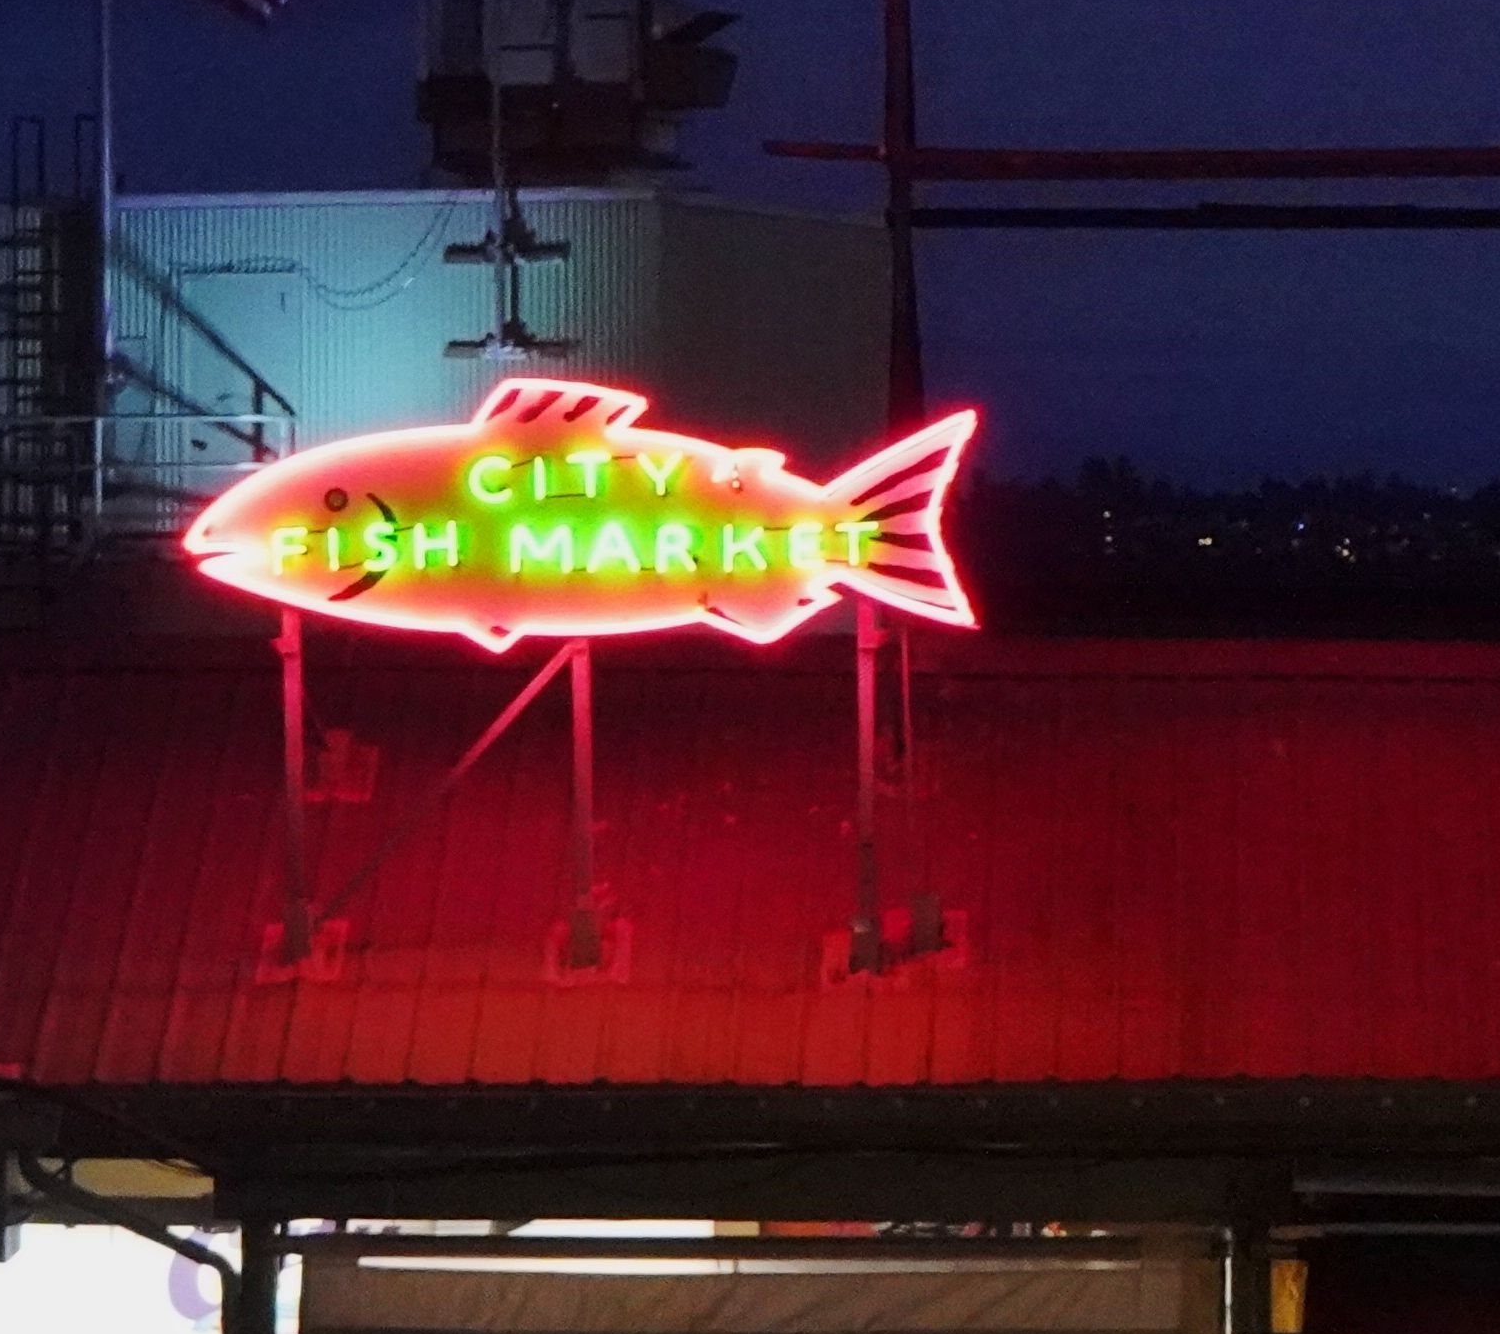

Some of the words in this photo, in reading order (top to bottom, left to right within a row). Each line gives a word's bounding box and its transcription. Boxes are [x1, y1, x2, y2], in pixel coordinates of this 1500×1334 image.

[468, 450, 682, 505] CITY
[271, 519, 460, 575] FISH
[509, 519, 880, 575] MARKET
